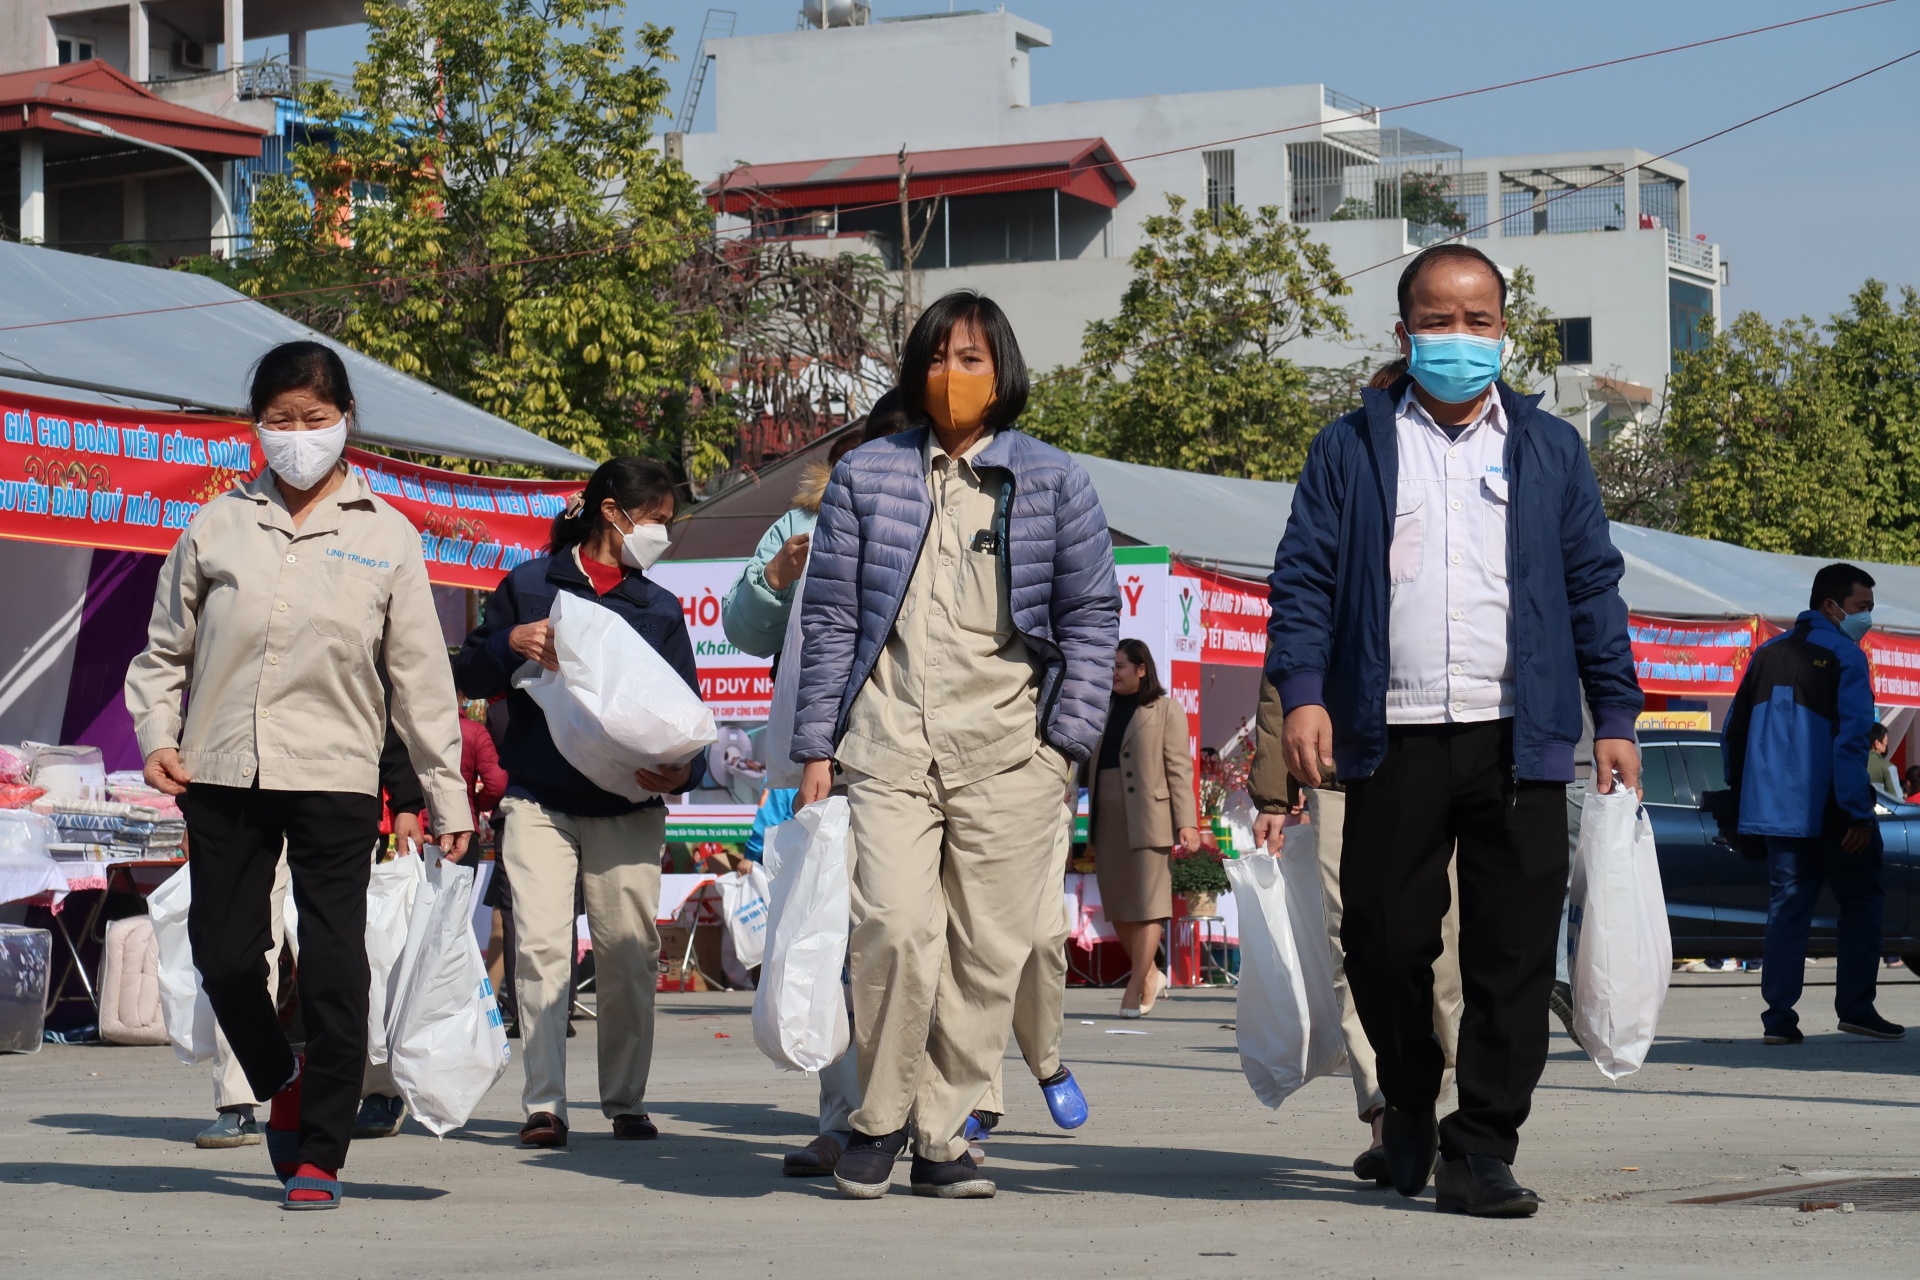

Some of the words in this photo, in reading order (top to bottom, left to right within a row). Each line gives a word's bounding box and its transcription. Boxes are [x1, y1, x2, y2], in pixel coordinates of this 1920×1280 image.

[4, 408, 33, 444] GIÁ
[36, 415, 70, 450] CHO
[73, 418, 119, 456] ĐOÀN
[122, 424, 159, 461] VIÊN
[161, 429, 207, 466] CÔNG
[208, 436, 251, 472] ĐOÀN
[51, 482, 88, 519] ĐÁN
[90, 487, 124, 524] QUÝ
[124, 491, 160, 527] MÃO
[366, 463, 403, 497] GIẢM
[401, 471, 427, 502] GIÁ
[423, 479, 453, 508] CHO
[493, 485, 530, 516] VIÊN
[326, 547, 345, 560] LINH
[438, 533, 471, 566] ĐÁN
[1208, 621, 1222, 650] TẾT
[715, 678, 750, 694] DUY
